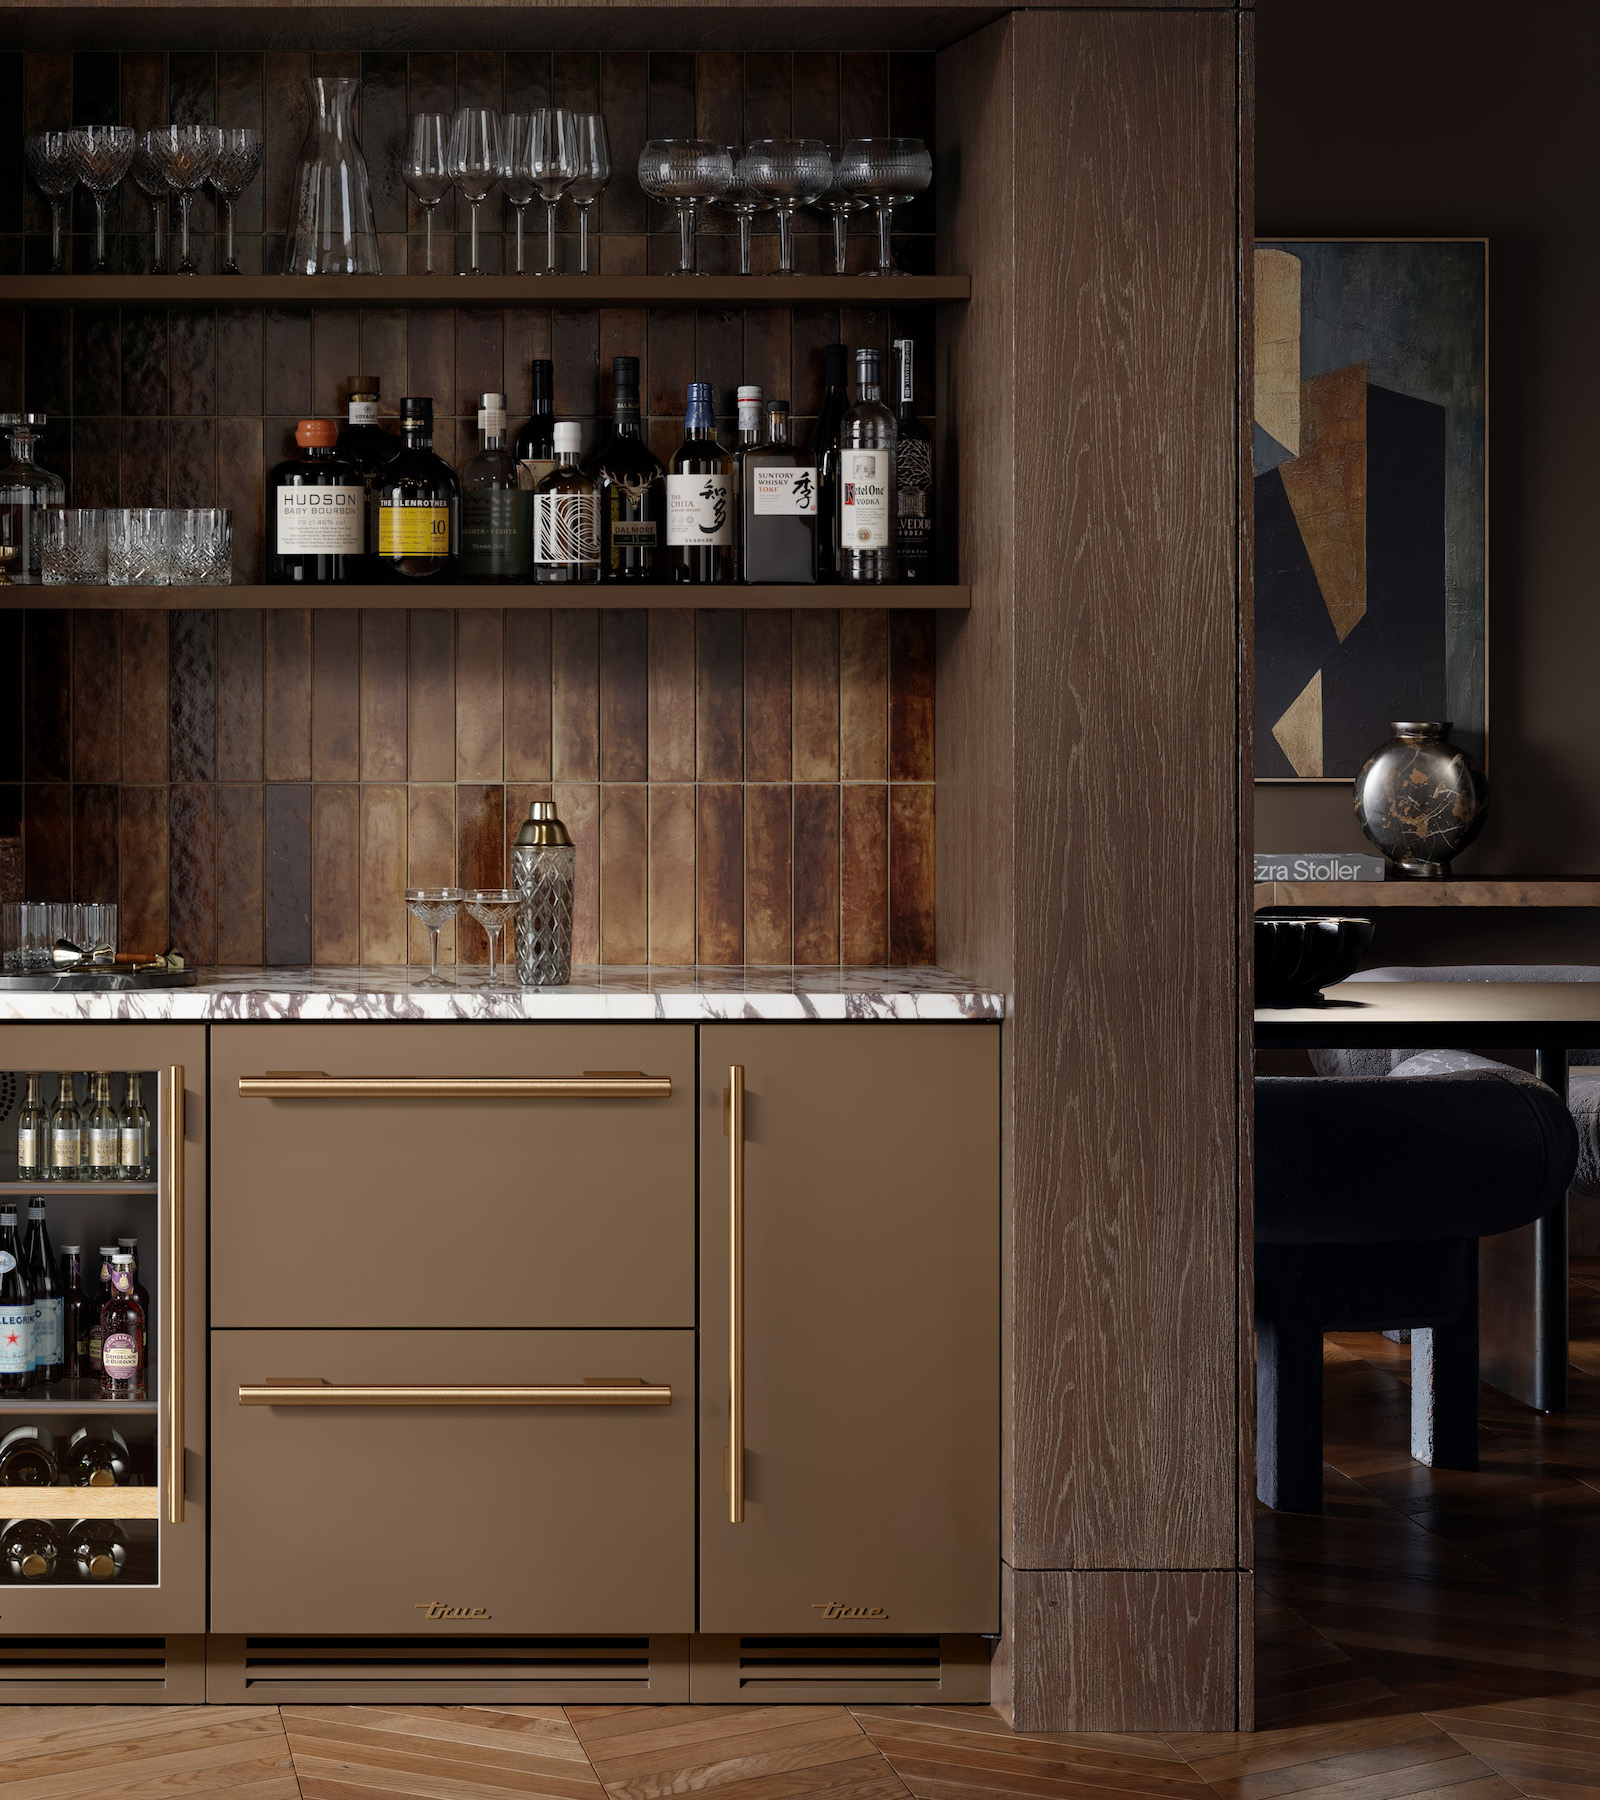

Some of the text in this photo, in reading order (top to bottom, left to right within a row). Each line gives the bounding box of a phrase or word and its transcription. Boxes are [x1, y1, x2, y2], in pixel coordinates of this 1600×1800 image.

[792, 471, 815, 509] 季
[845, 483, 884, 505] Ketel One
[284, 494, 356, 505] HUDSON
[284, 507, 356, 515] BABY BOURBON
[430, 520, 446, 535] 10
[614, 526, 655, 534] DALMORE
[1293, 860, 1362, 881] Stoller
